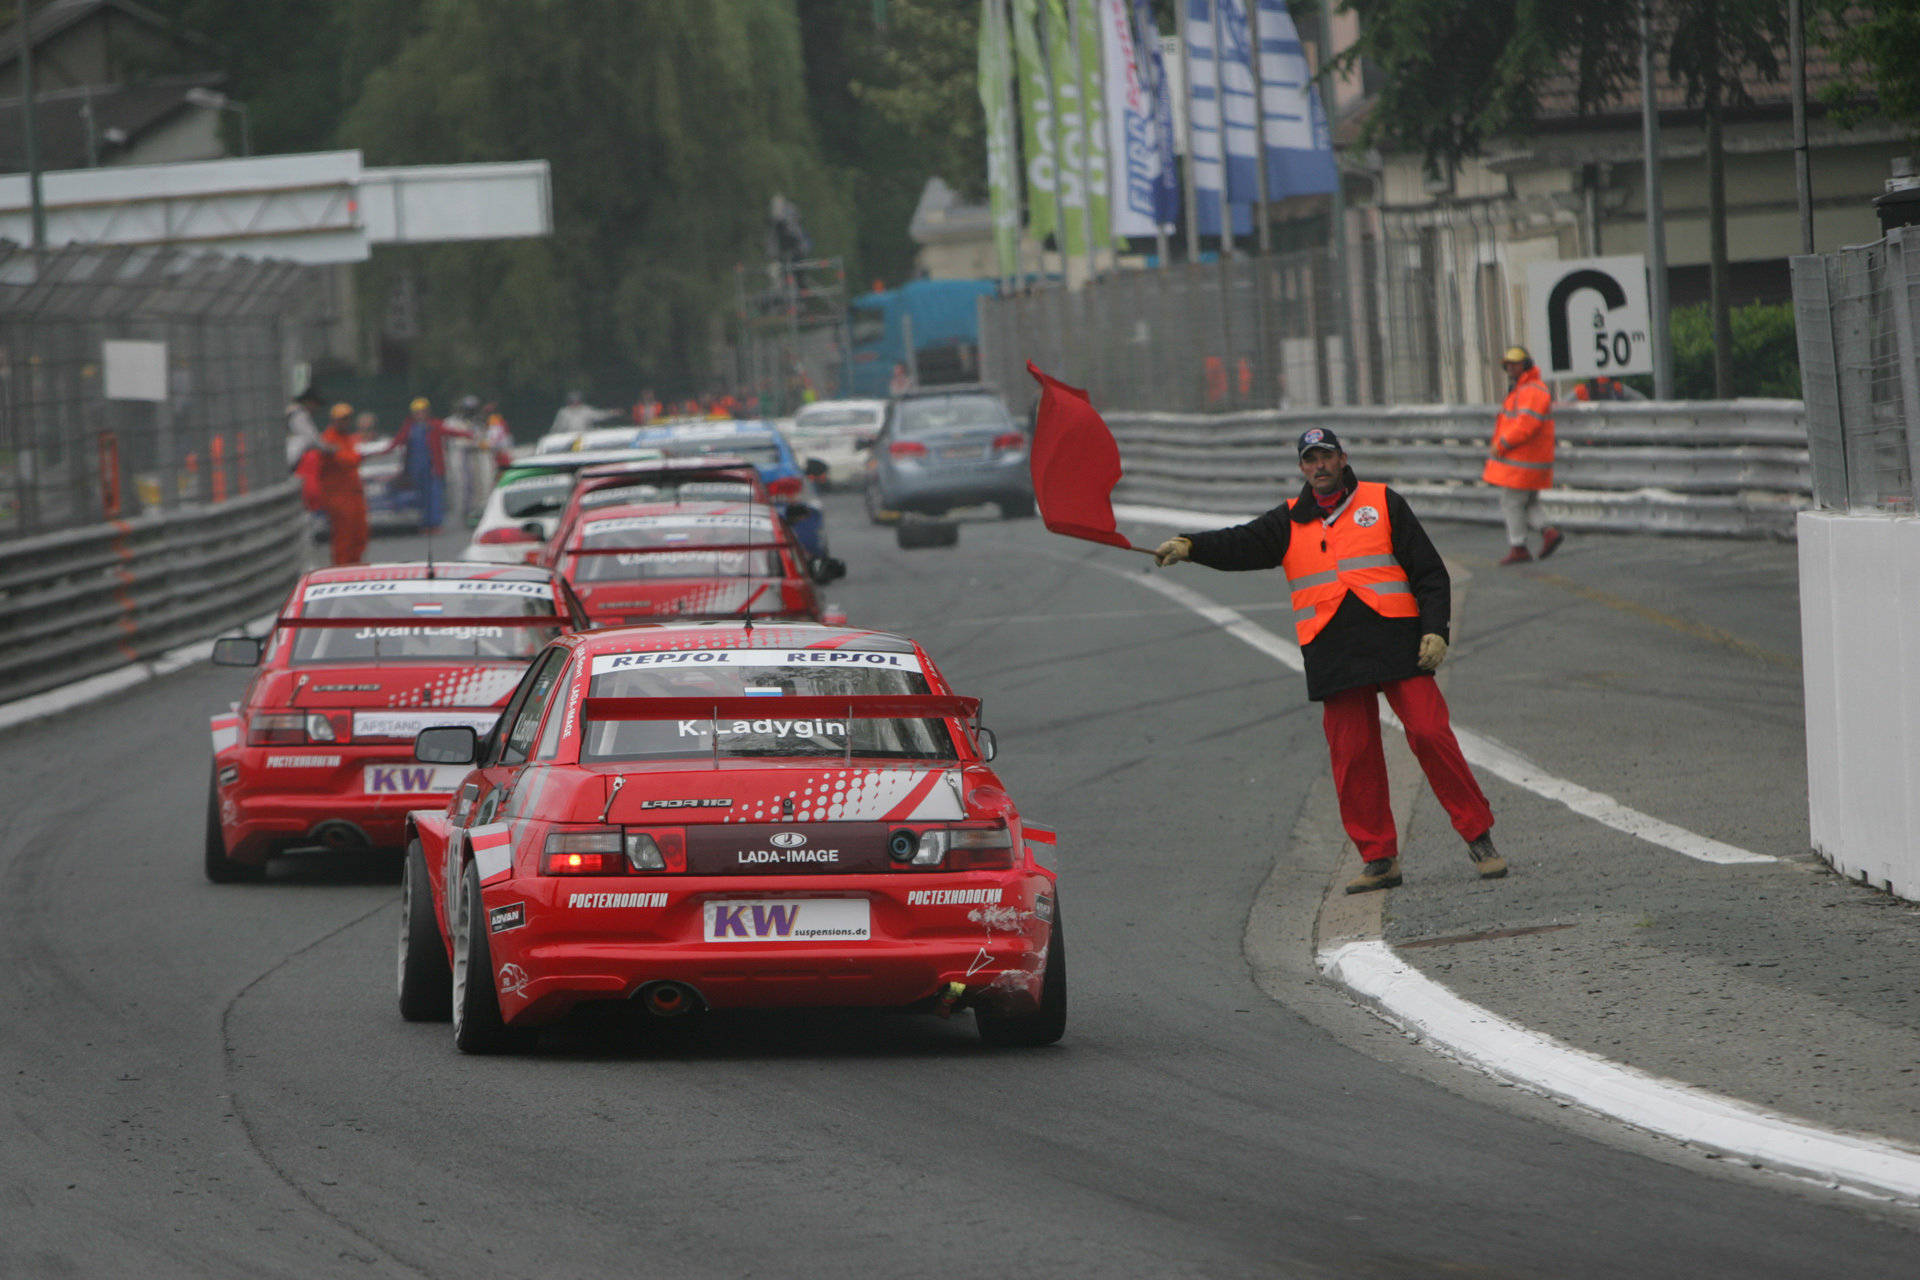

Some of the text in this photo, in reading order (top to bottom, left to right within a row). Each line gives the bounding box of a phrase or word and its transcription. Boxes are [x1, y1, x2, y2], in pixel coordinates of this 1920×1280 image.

[1593, 307, 1605, 328] à
[310, 583, 545, 597] REPSOL REPSOL
[612, 652, 902, 668] REPSOL REPSOL
[562, 683, 582, 740] LADA-IMAGE
[361, 720, 422, 733] AFSTAND
[678, 718, 846, 739] K. Ladygin
[372, 768, 436, 792] KW
[738, 850, 839, 864] LADA-IMAGE
[568, 893, 668, 908] РОСТЕХНОЛОГИИ
[907, 888, 1003, 906] РОСТЕХНОЛОГИИ
[491, 910, 519, 926] ADVAN
[713, 905, 868, 938] KW suspensions.de
